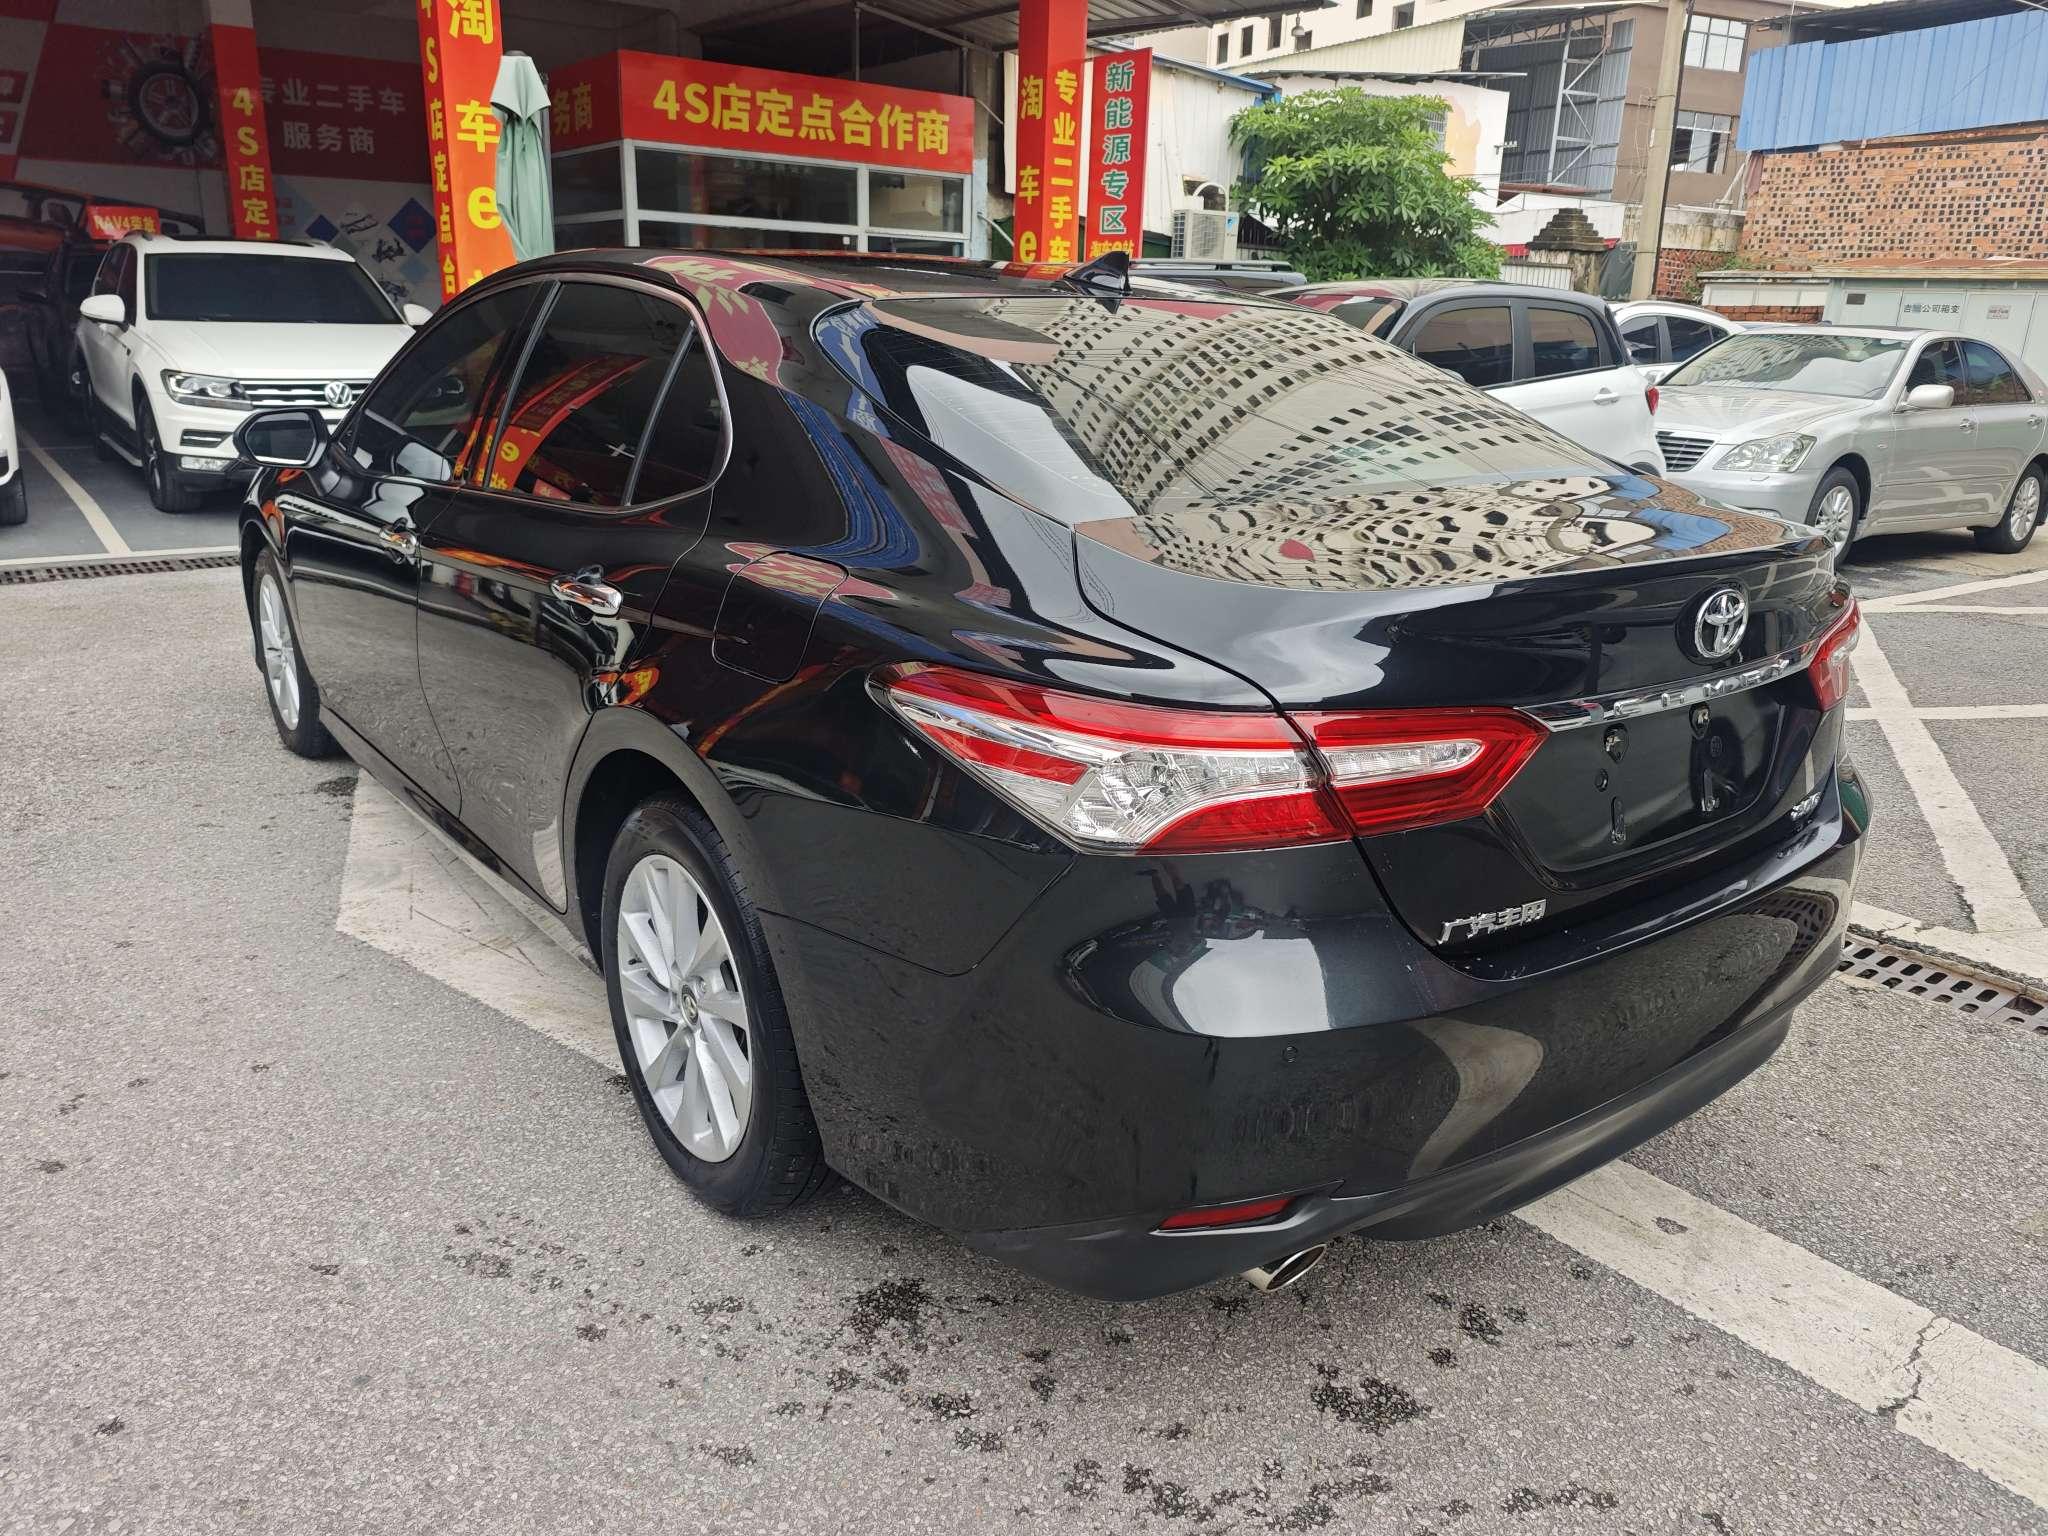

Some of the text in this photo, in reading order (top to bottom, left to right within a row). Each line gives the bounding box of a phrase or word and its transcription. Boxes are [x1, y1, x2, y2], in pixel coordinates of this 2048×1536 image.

[283, 120, 376, 154] 服务商
[449, 0, 500, 287] 淘车e
[653, 79, 950, 156] 4S店定点合作商
[1047, 69, 1078, 264] 专业二手车
[1100, 60, 1136, 236] 新能源专区
